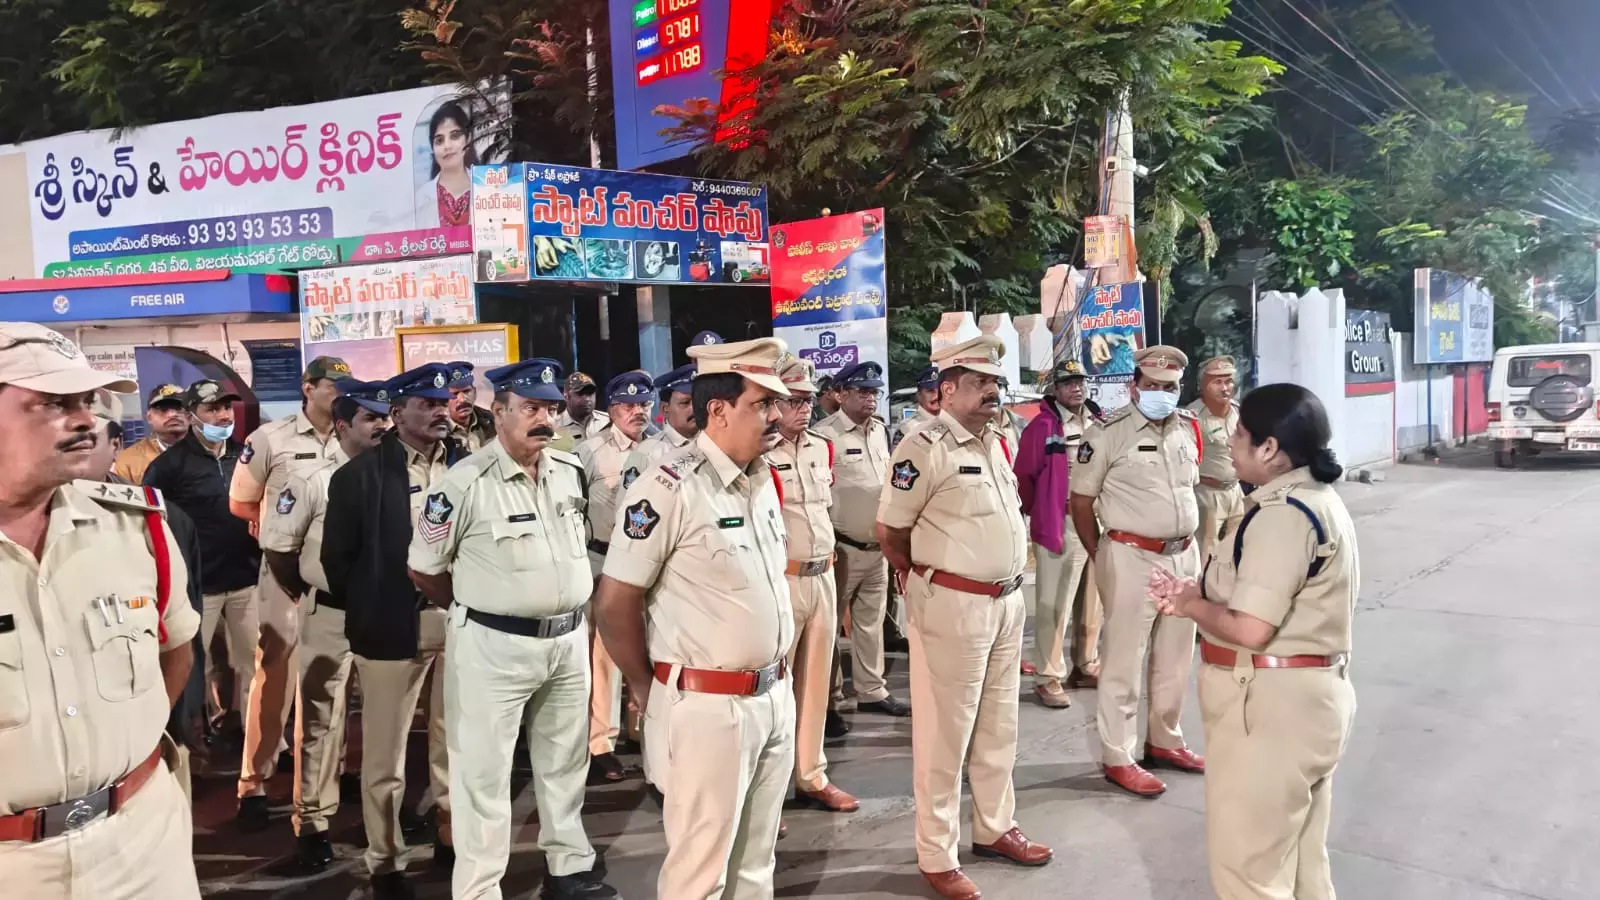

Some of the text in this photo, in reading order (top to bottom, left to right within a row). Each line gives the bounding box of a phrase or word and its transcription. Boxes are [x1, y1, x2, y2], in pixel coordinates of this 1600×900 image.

[635, 4, 657, 21] Petrol
[636, 33, 659, 50] Diesel
[665, 45, 700, 75] 11788
[34, 152, 66, 221] శ్రీ
[70, 146, 138, 217] స్కిన్
[147, 161, 170, 195] &
[316, 112, 402, 193] క్లినిక్
[532, 185, 763, 241] స్పాట్ పంచర్ షాపు
[188, 224, 210, 244] 93
[215, 220, 237, 241] 93
[242, 217, 264, 239] 93
[271, 214, 292, 236] 53
[299, 212, 321, 234] 53
[278, 245, 299, 262] గేట్
[430, 234, 447, 254] రెడ్డి
[130, 293, 185, 307] FREE AIR
[1094, 285, 1121, 309] స్పాట్
[1082, 309, 1115, 331] పంచర్
[1344, 319, 1364, 341] olice
[425, 338, 503, 356] PRAHAS
